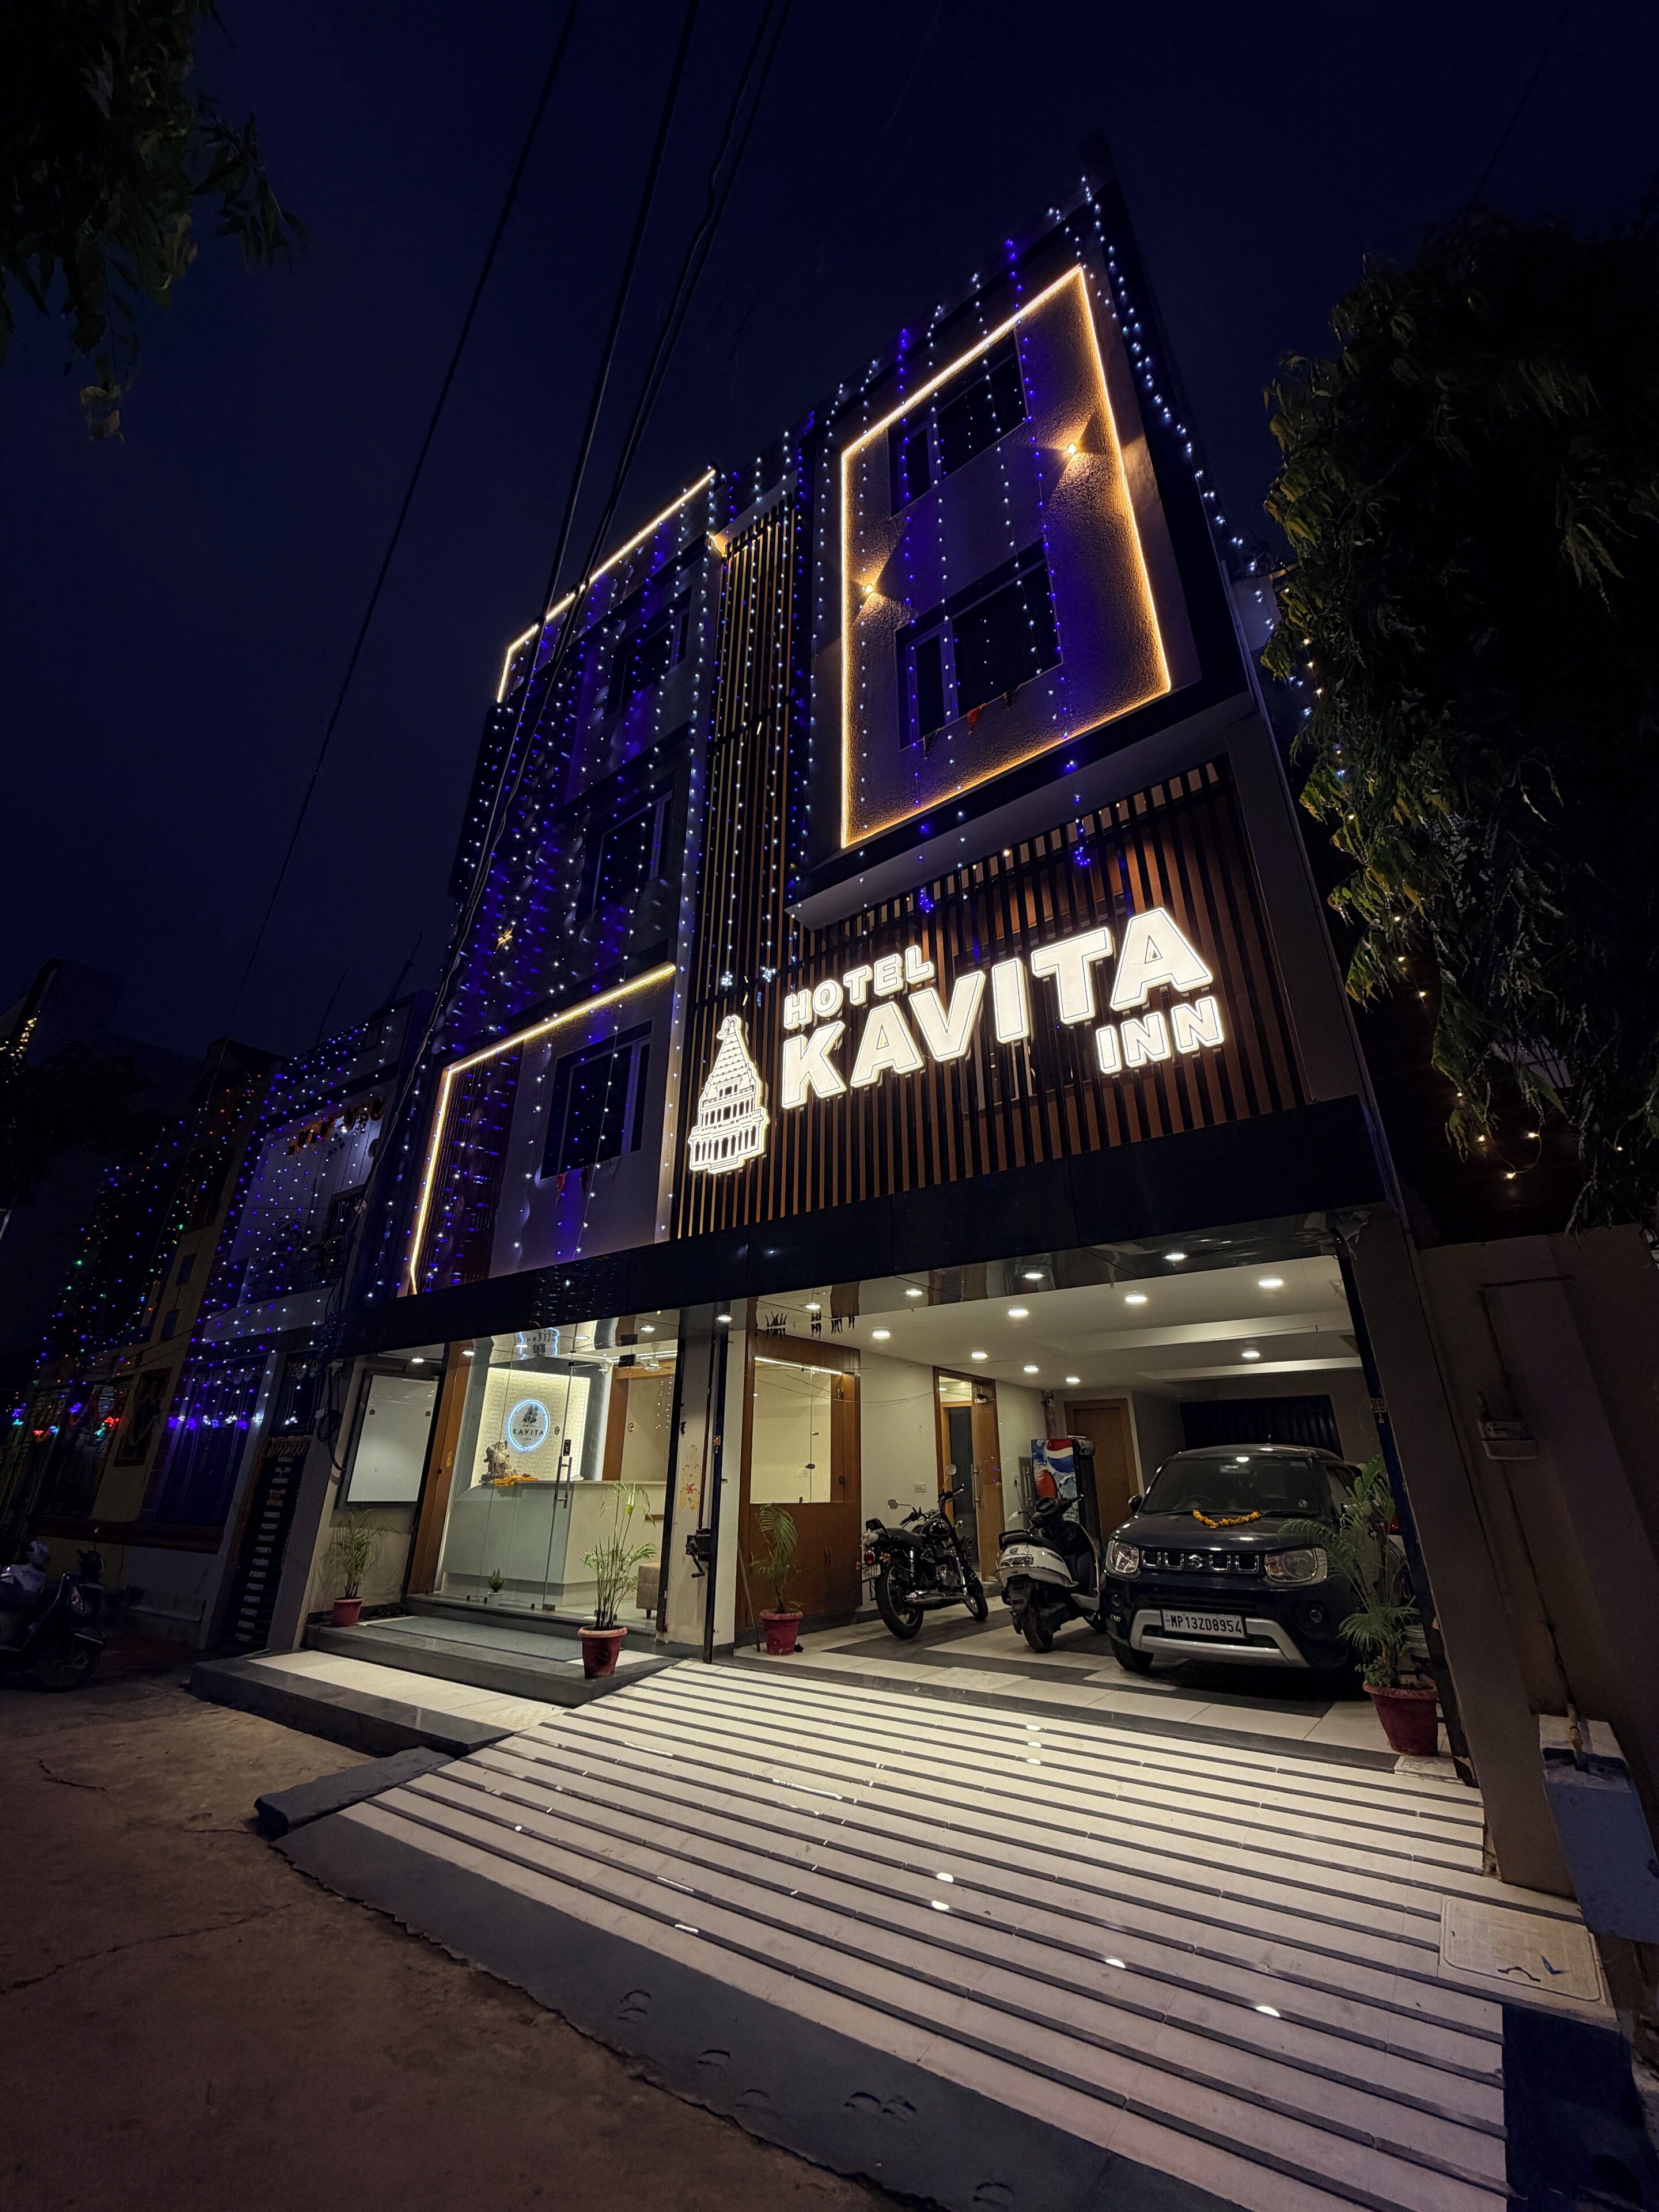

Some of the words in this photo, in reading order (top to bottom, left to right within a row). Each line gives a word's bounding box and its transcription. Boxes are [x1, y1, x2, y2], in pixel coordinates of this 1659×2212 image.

[781, 906, 1214, 1109] KAVITA
[783, 945, 935, 1030] HOTEL
[1096, 996, 1225, 1074] INN
[1170, 1615, 1242, 1634] MP13ZD8954
